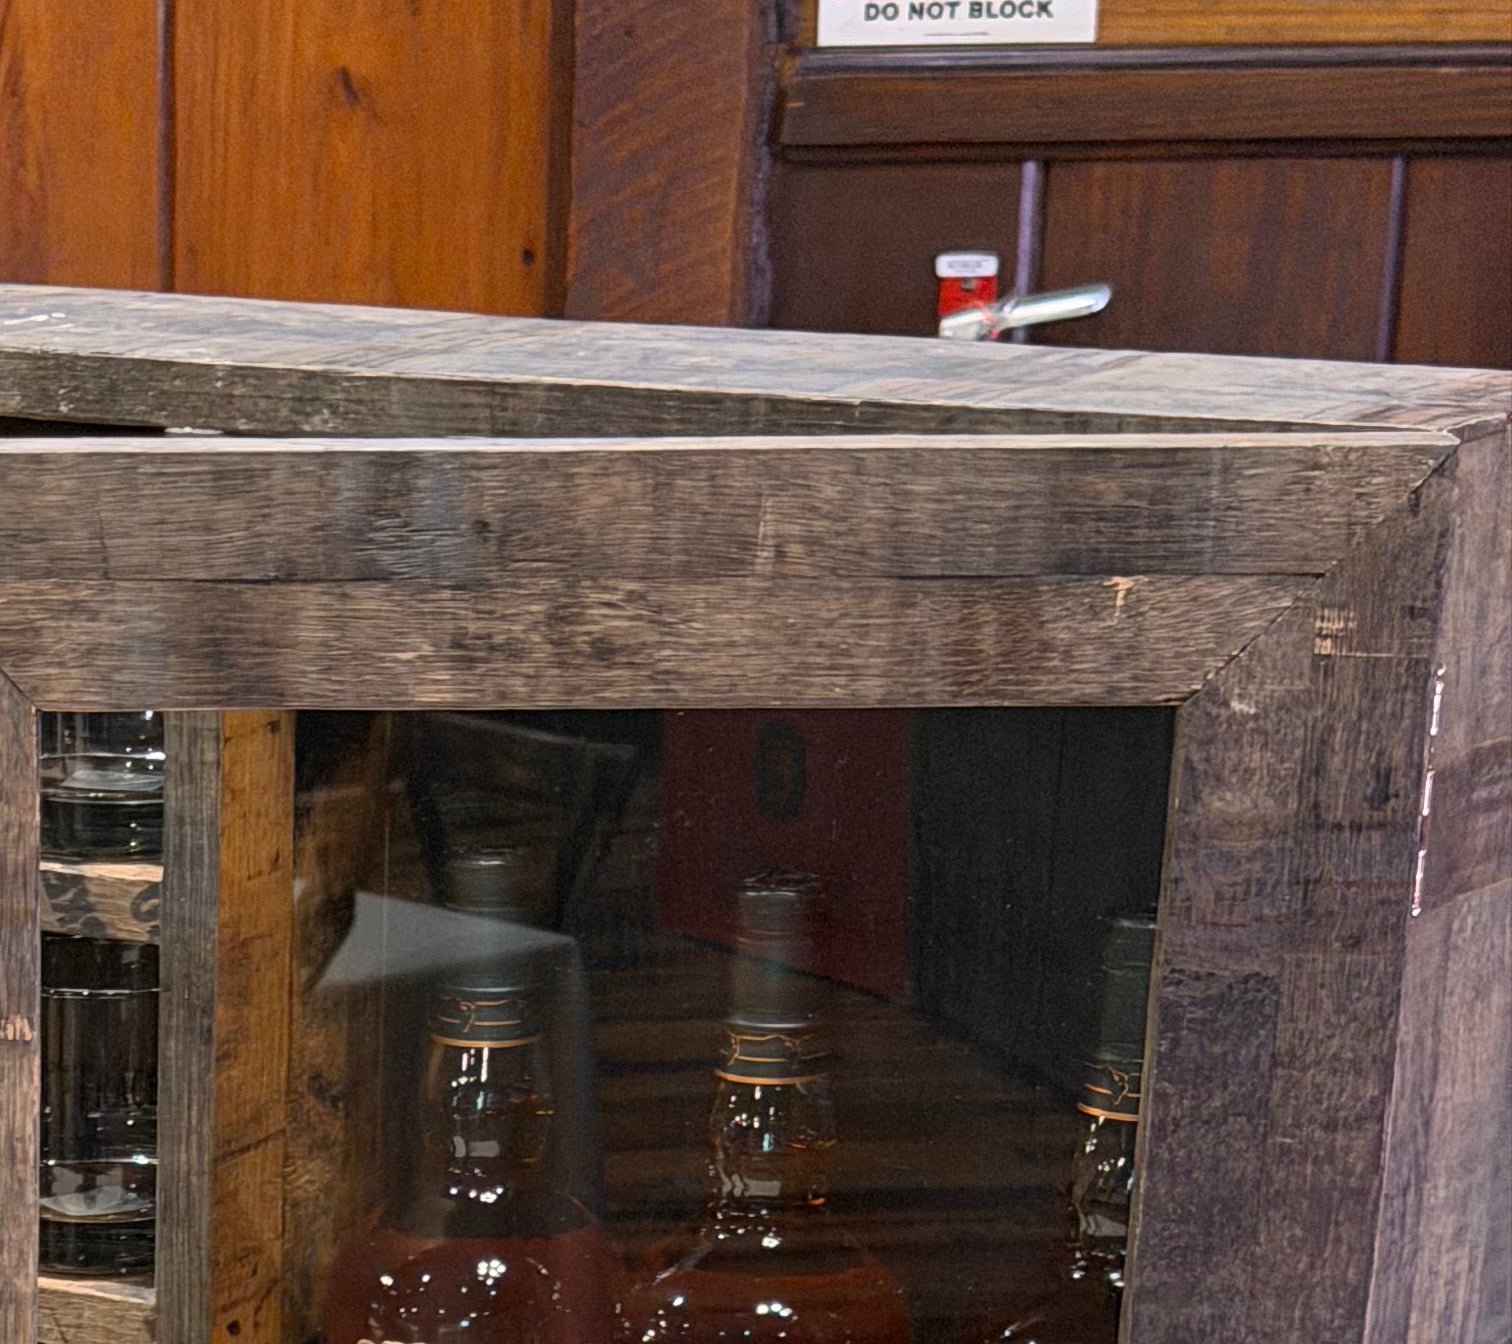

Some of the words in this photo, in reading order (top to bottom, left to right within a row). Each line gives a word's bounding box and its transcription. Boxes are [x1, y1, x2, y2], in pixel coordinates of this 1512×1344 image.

[864, 2, 900, 22] DO
[908, 1, 961, 20] NOT
[968, 0, 1054, 20] BLOCK
